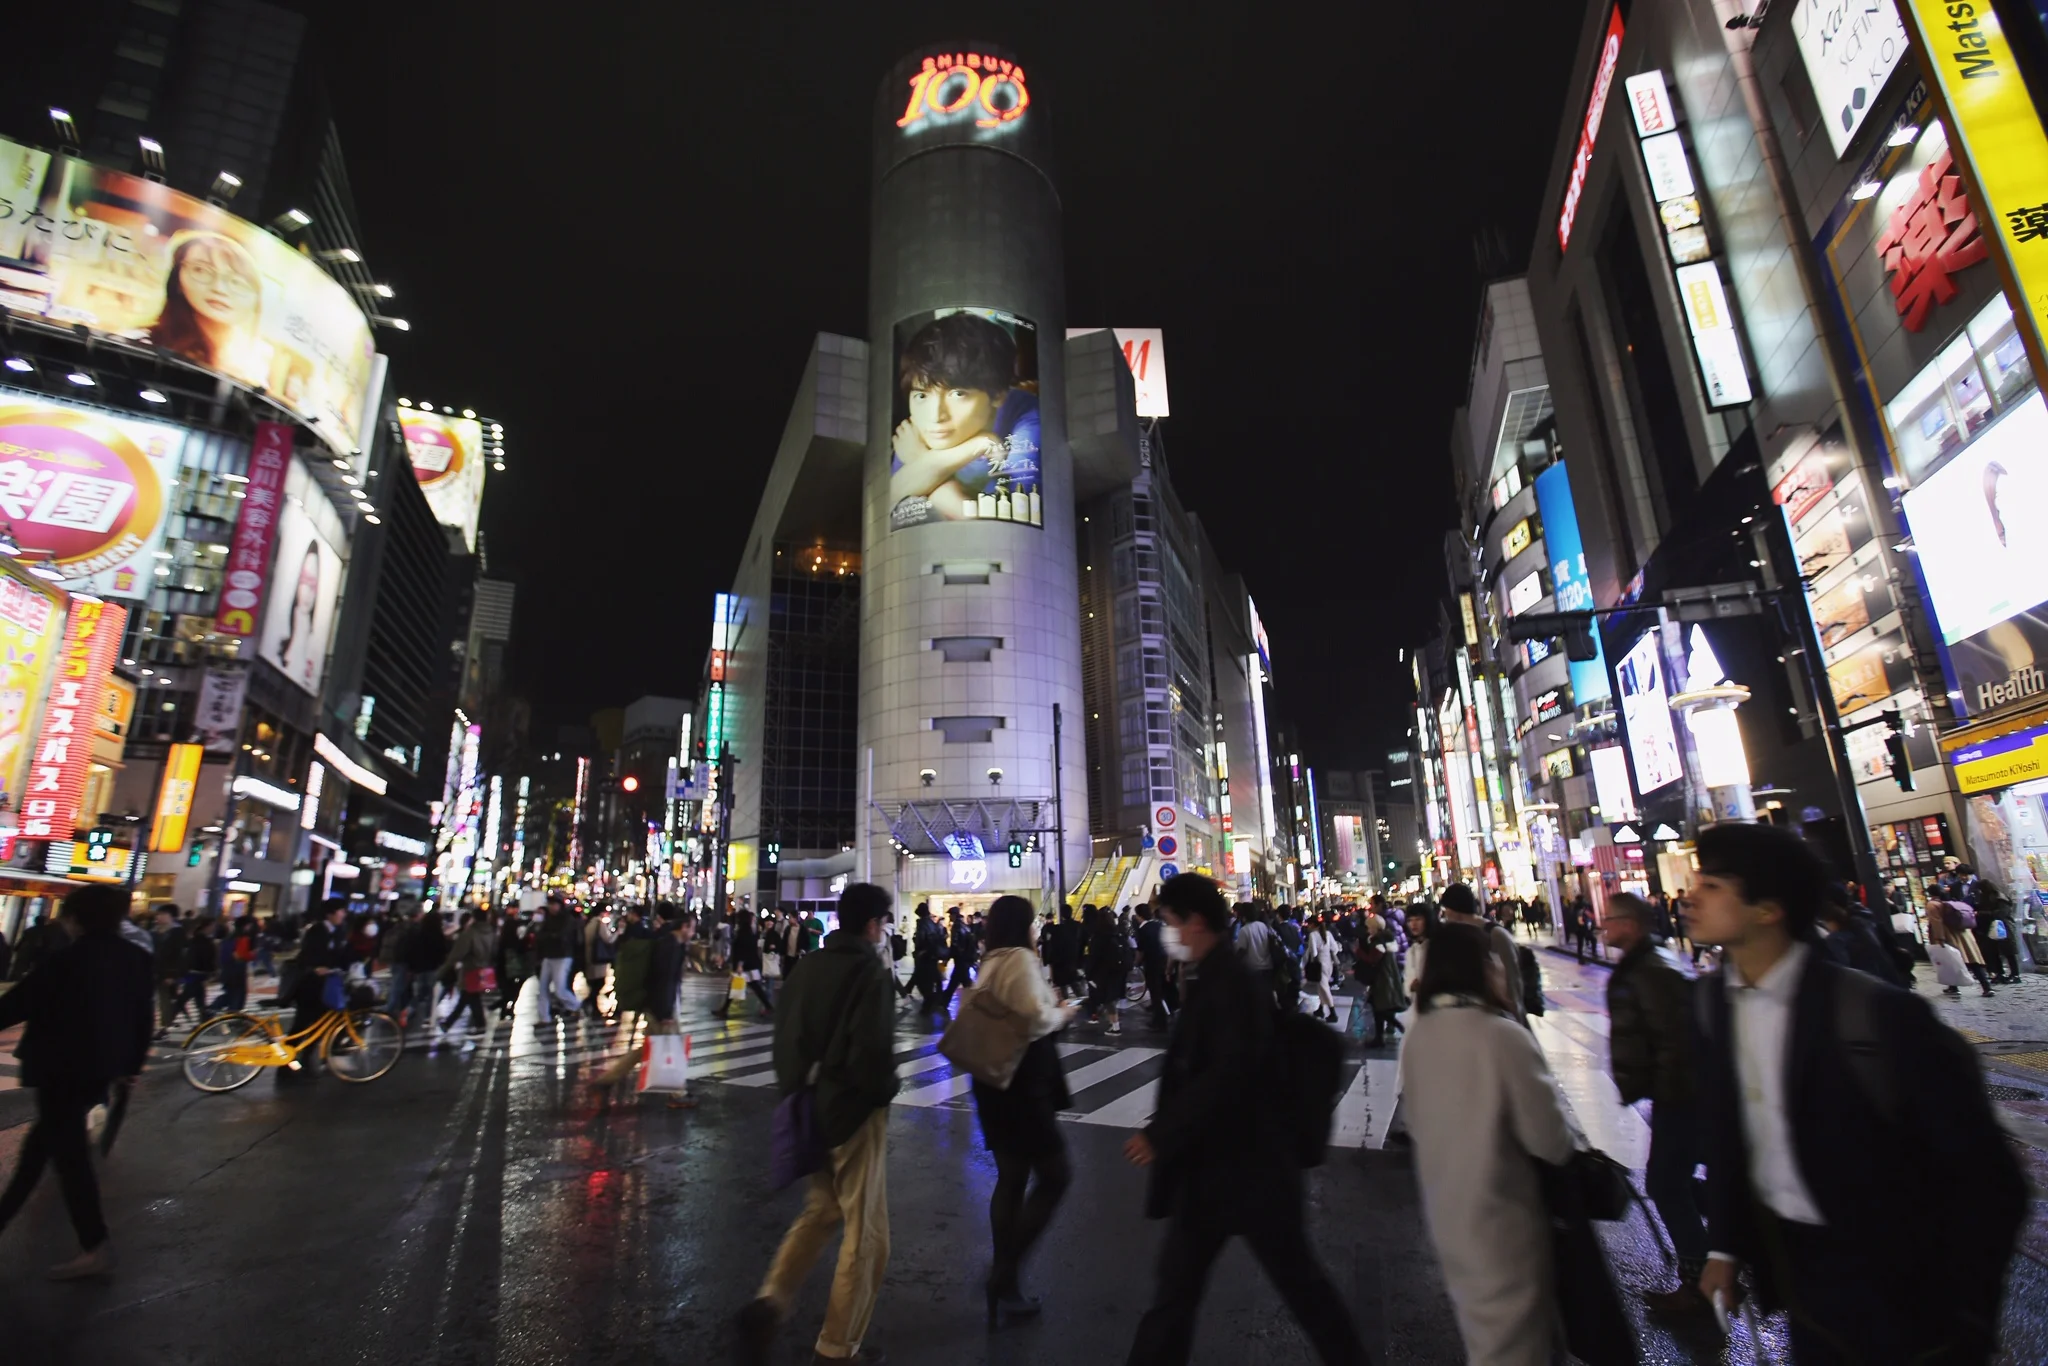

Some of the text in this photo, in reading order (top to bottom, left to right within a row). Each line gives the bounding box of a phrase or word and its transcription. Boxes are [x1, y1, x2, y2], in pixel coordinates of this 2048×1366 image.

[922, 53, 1025, 82] SHIBUYA
[1839, 0, 1882, 73] SOFIN
[1944, 0, 1999, 79] Mats
[896, 64, 1031, 128] 109
[0, 458, 134, 533] 楽園
[237, 448, 283, 570] 品川美容外科
[892, 501, 933, 517] LAVONS
[65, 600, 104, 677] パチンコ
[1977, 664, 2046, 710] Health
[1965, 770, 2009, 785] Matsumoto
[1160, 812, 1172, 822] 30
